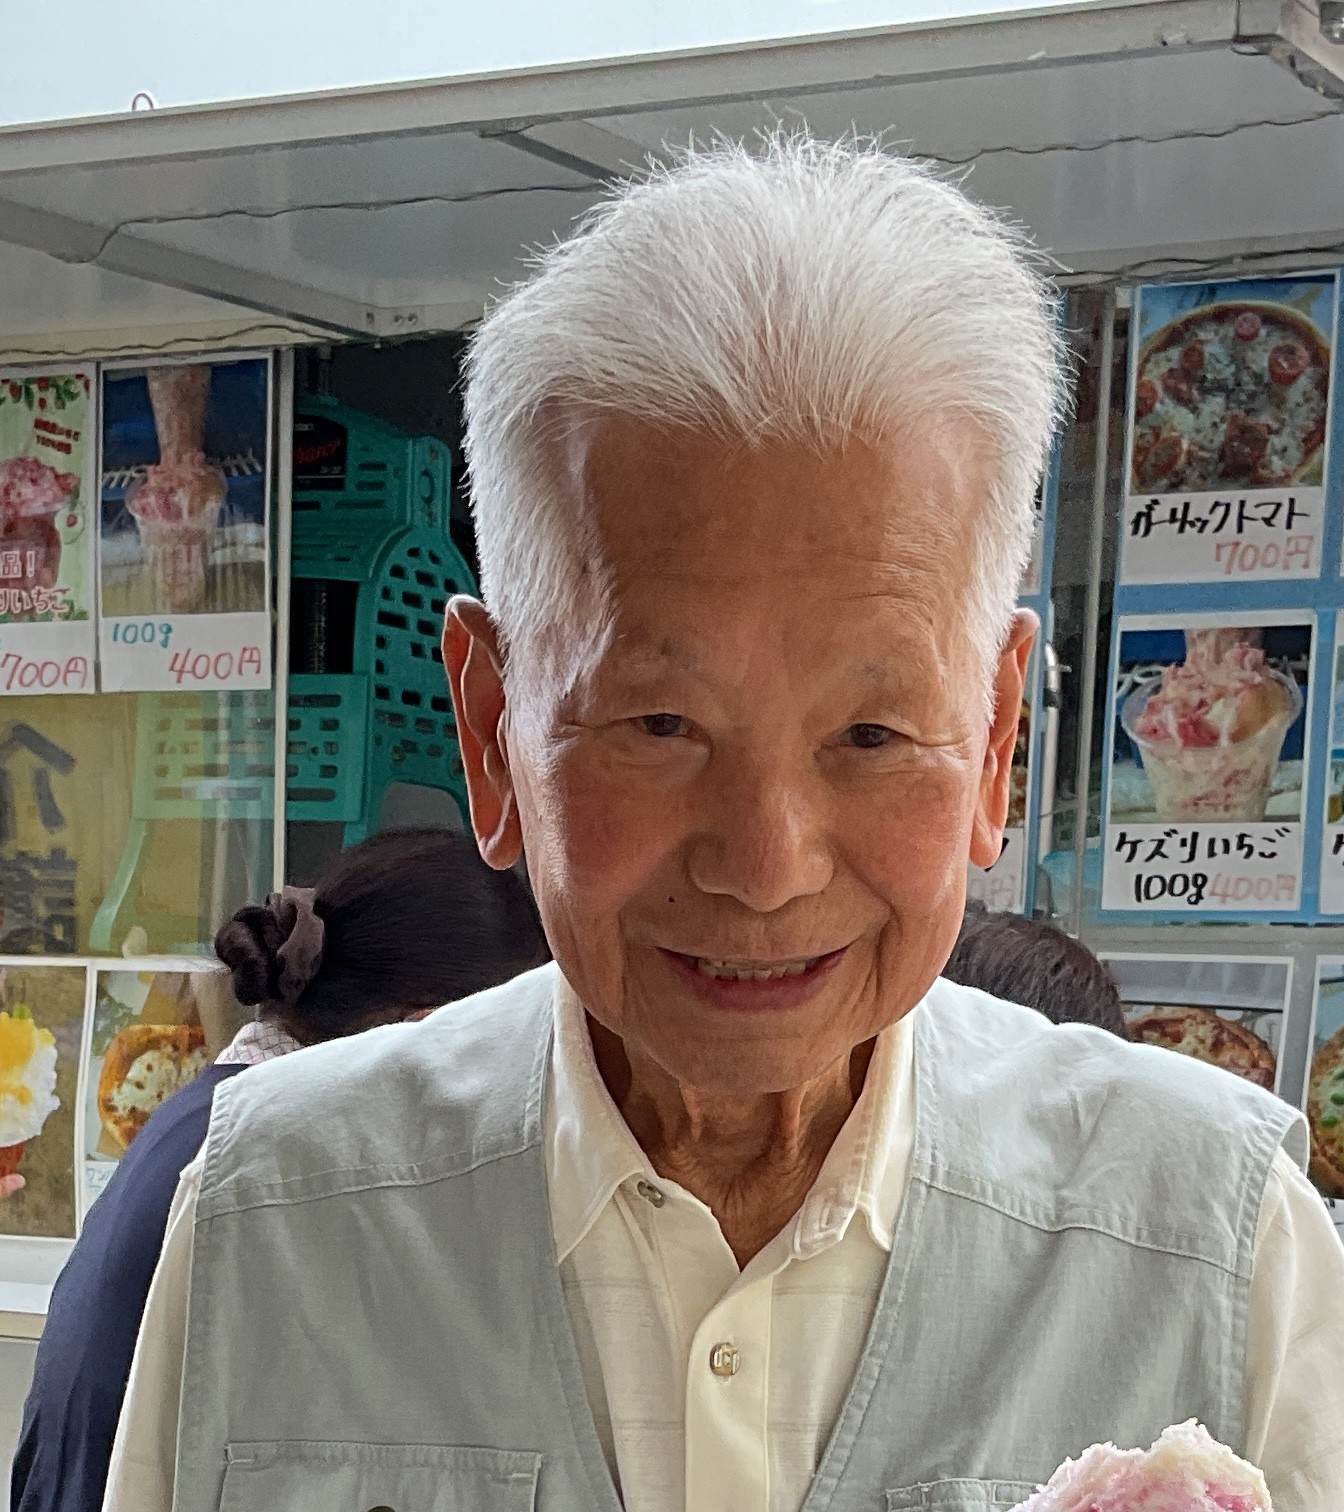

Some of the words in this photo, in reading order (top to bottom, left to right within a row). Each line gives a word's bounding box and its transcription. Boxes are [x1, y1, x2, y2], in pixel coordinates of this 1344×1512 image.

[1130, 498, 1311, 538] ガーリックトマト
[1214, 534, 1315, 575] 700円
[112, 622, 173, 649] 100g
[0, 652, 88, 690] 700円
[168, 647, 262, 684] 400円
[1134, 873, 1208, 906] 100g
[1208, 873, 1297, 904] 400円
